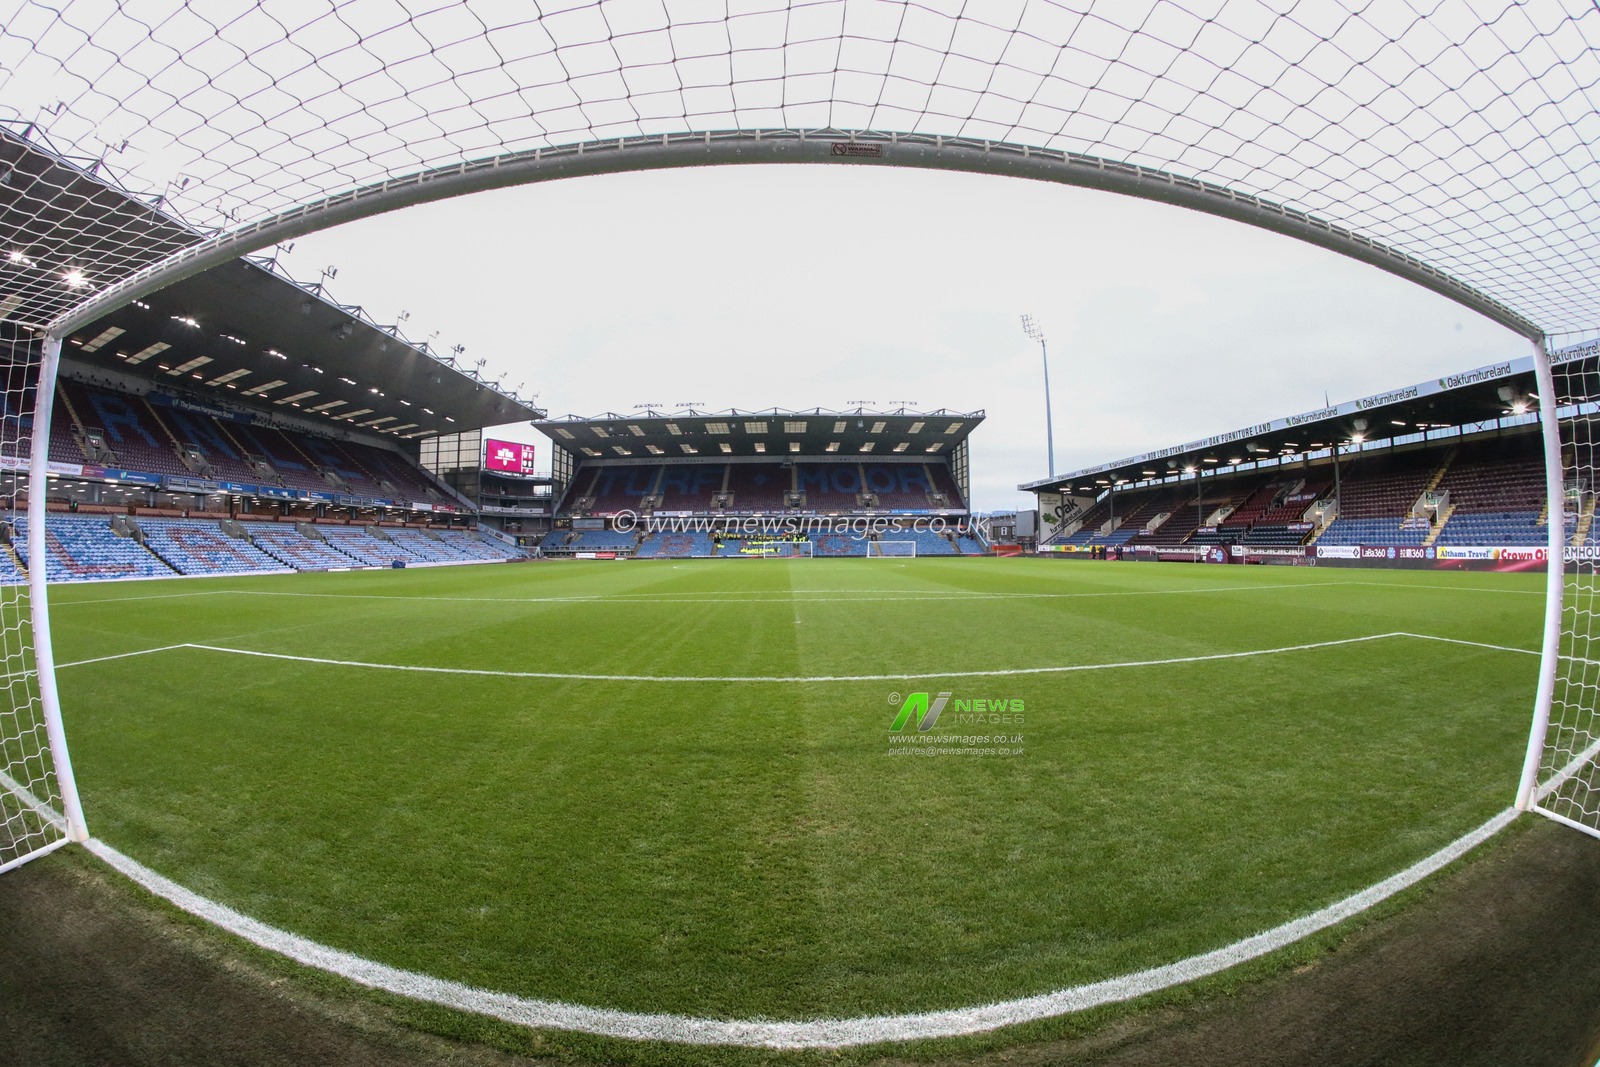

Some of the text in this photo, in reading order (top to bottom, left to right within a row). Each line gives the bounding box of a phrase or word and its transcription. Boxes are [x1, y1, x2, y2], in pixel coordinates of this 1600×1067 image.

[1547, 341, 1600, 364] akfurniturel
[1447, 363, 1511, 388] Oakfurnitureland
[1362, 387, 1418, 409] Oakfurnitureland
[1291, 407, 1338, 425] Oakfurnitureland
[1169, 445, 1184, 456] STAND
[1209, 436, 1220, 446] OAK
[1221, 427, 1253, 443] FURNITURE
[1255, 422, 1272, 434] LAND
[1055, 498, 1078, 519] Oak
[1362, 549, 1385, 558] LaBa360
[1440, 550, 1467, 558] Althams
[1501, 549, 1547, 560] Crown Oi
[1564, 547, 1600, 558] RMHOU
